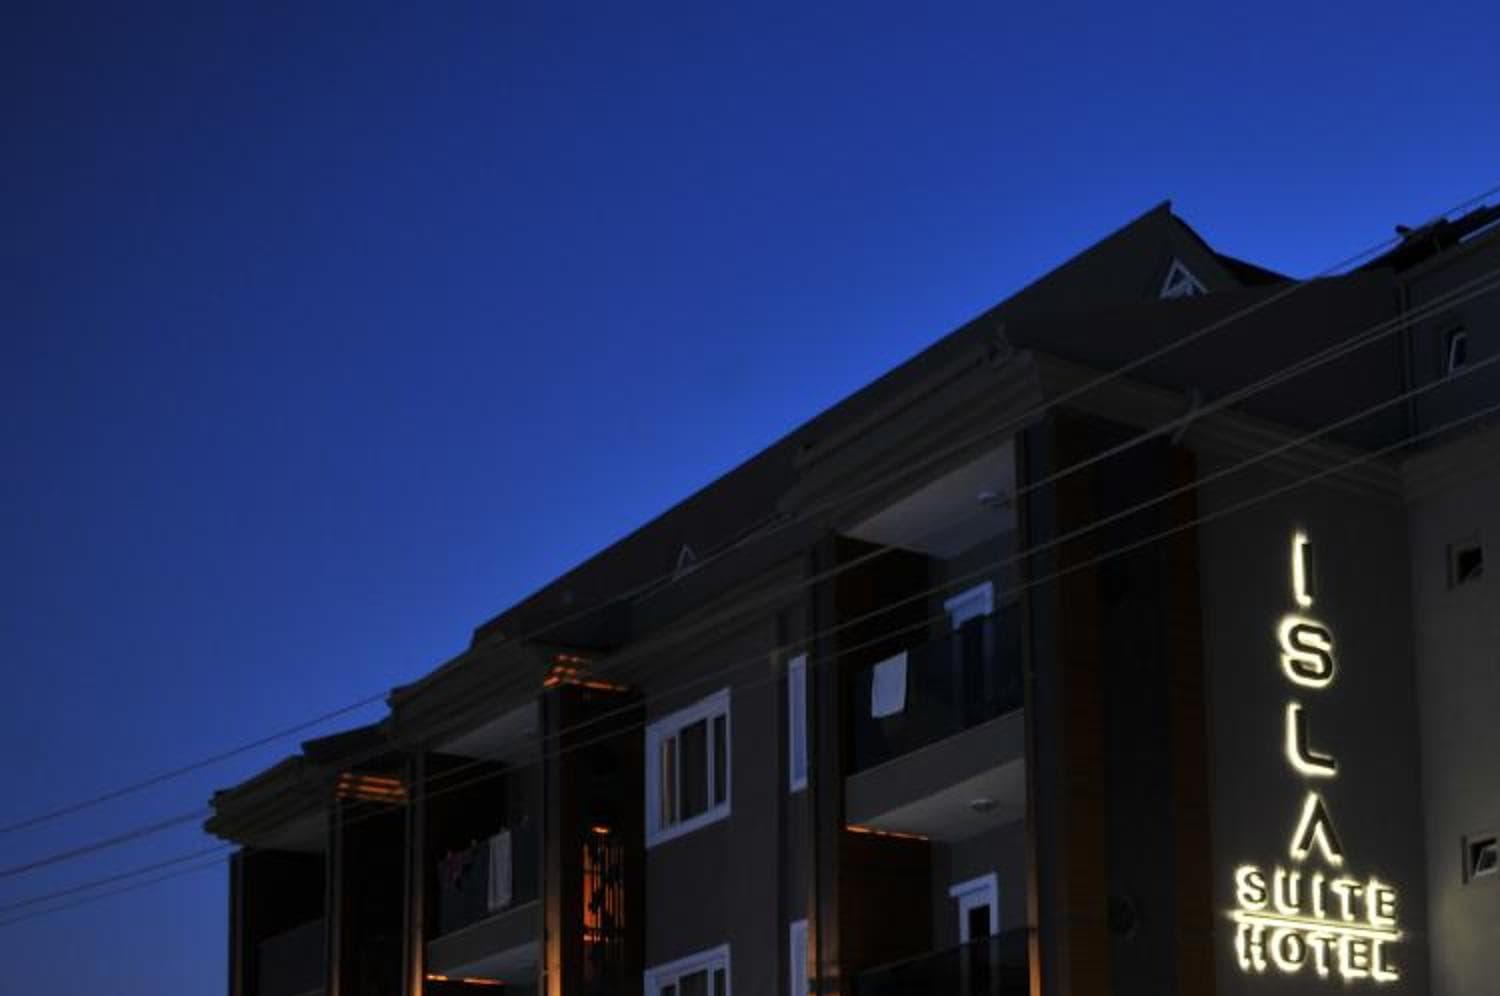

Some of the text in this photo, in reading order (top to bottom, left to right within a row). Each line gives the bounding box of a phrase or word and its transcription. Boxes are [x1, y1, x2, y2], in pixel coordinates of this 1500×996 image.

[1278, 530, 1342, 866] ISLA
[1234, 864, 1398, 928] SUITE
[1234, 922, 1399, 982] HOTEL
